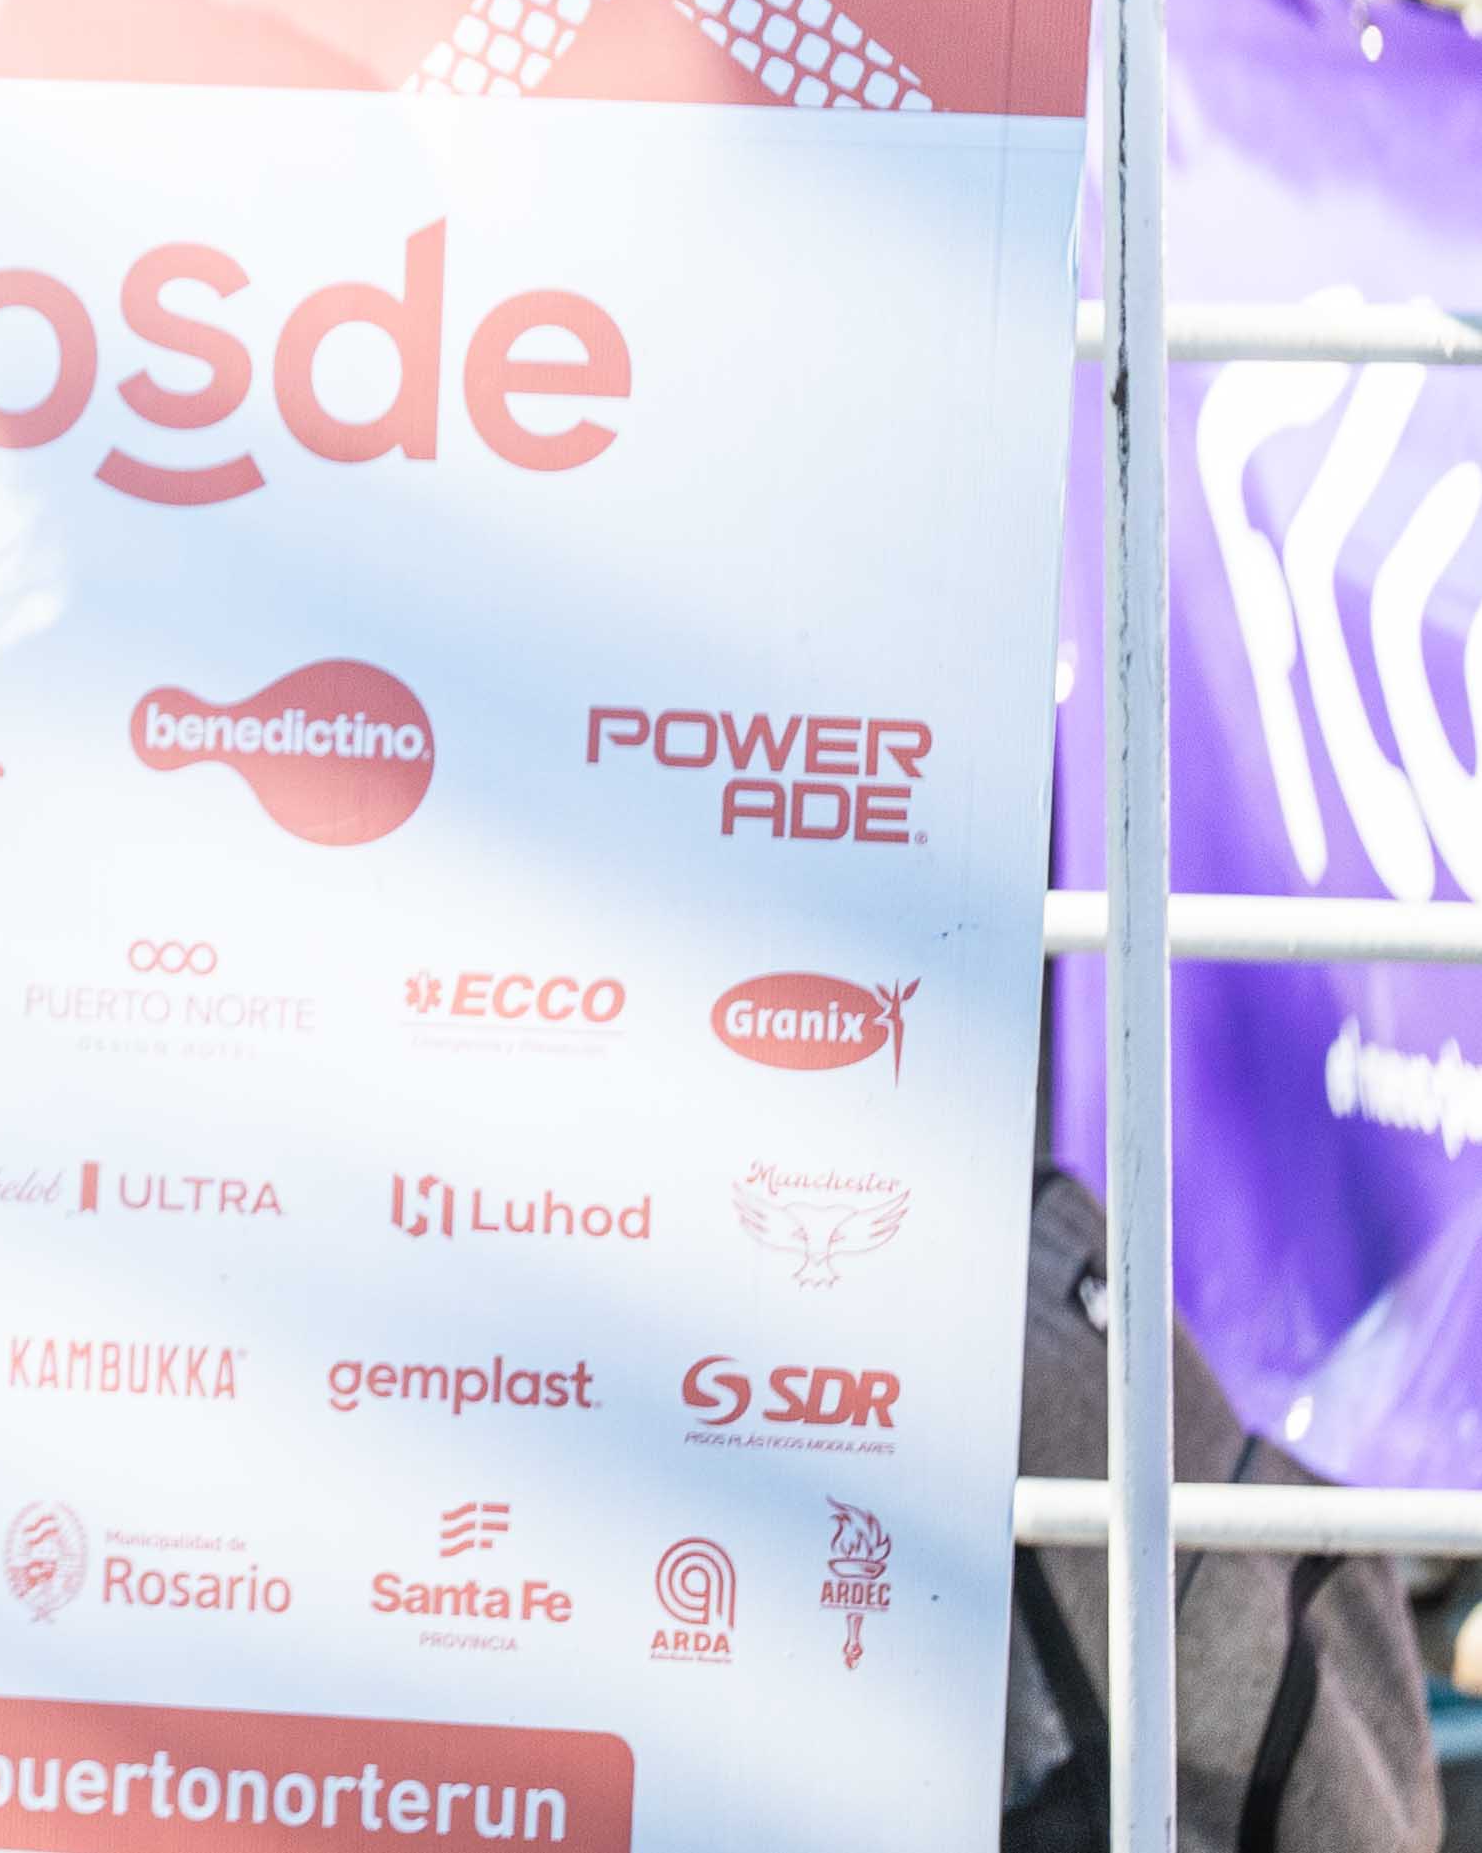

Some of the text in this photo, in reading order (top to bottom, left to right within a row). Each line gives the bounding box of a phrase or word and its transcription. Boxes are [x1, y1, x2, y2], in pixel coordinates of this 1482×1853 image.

[586, 705, 933, 779] POWER
[720, 778, 913, 844] ADE
[449, 972, 627, 1024] ECCO
[723, 998, 867, 1044] Granix
[118, 1172, 284, 1217] ULTRA
[745, 1159, 902, 1196] Manchester
[470, 1188, 652, 1240] Luhod
[9, 1335, 238, 1400] KAMBUKKA
[762, 1364, 901, 1429] SDR
[102, 1556, 294, 1614] Rosario
[370, 1571, 573, 1623] Santa Fe
[819, 1579, 892, 1608] ARDEC
[418, 1630, 518, 1653] PROVINCIA
[650, 1629, 732, 1654] ARDA
